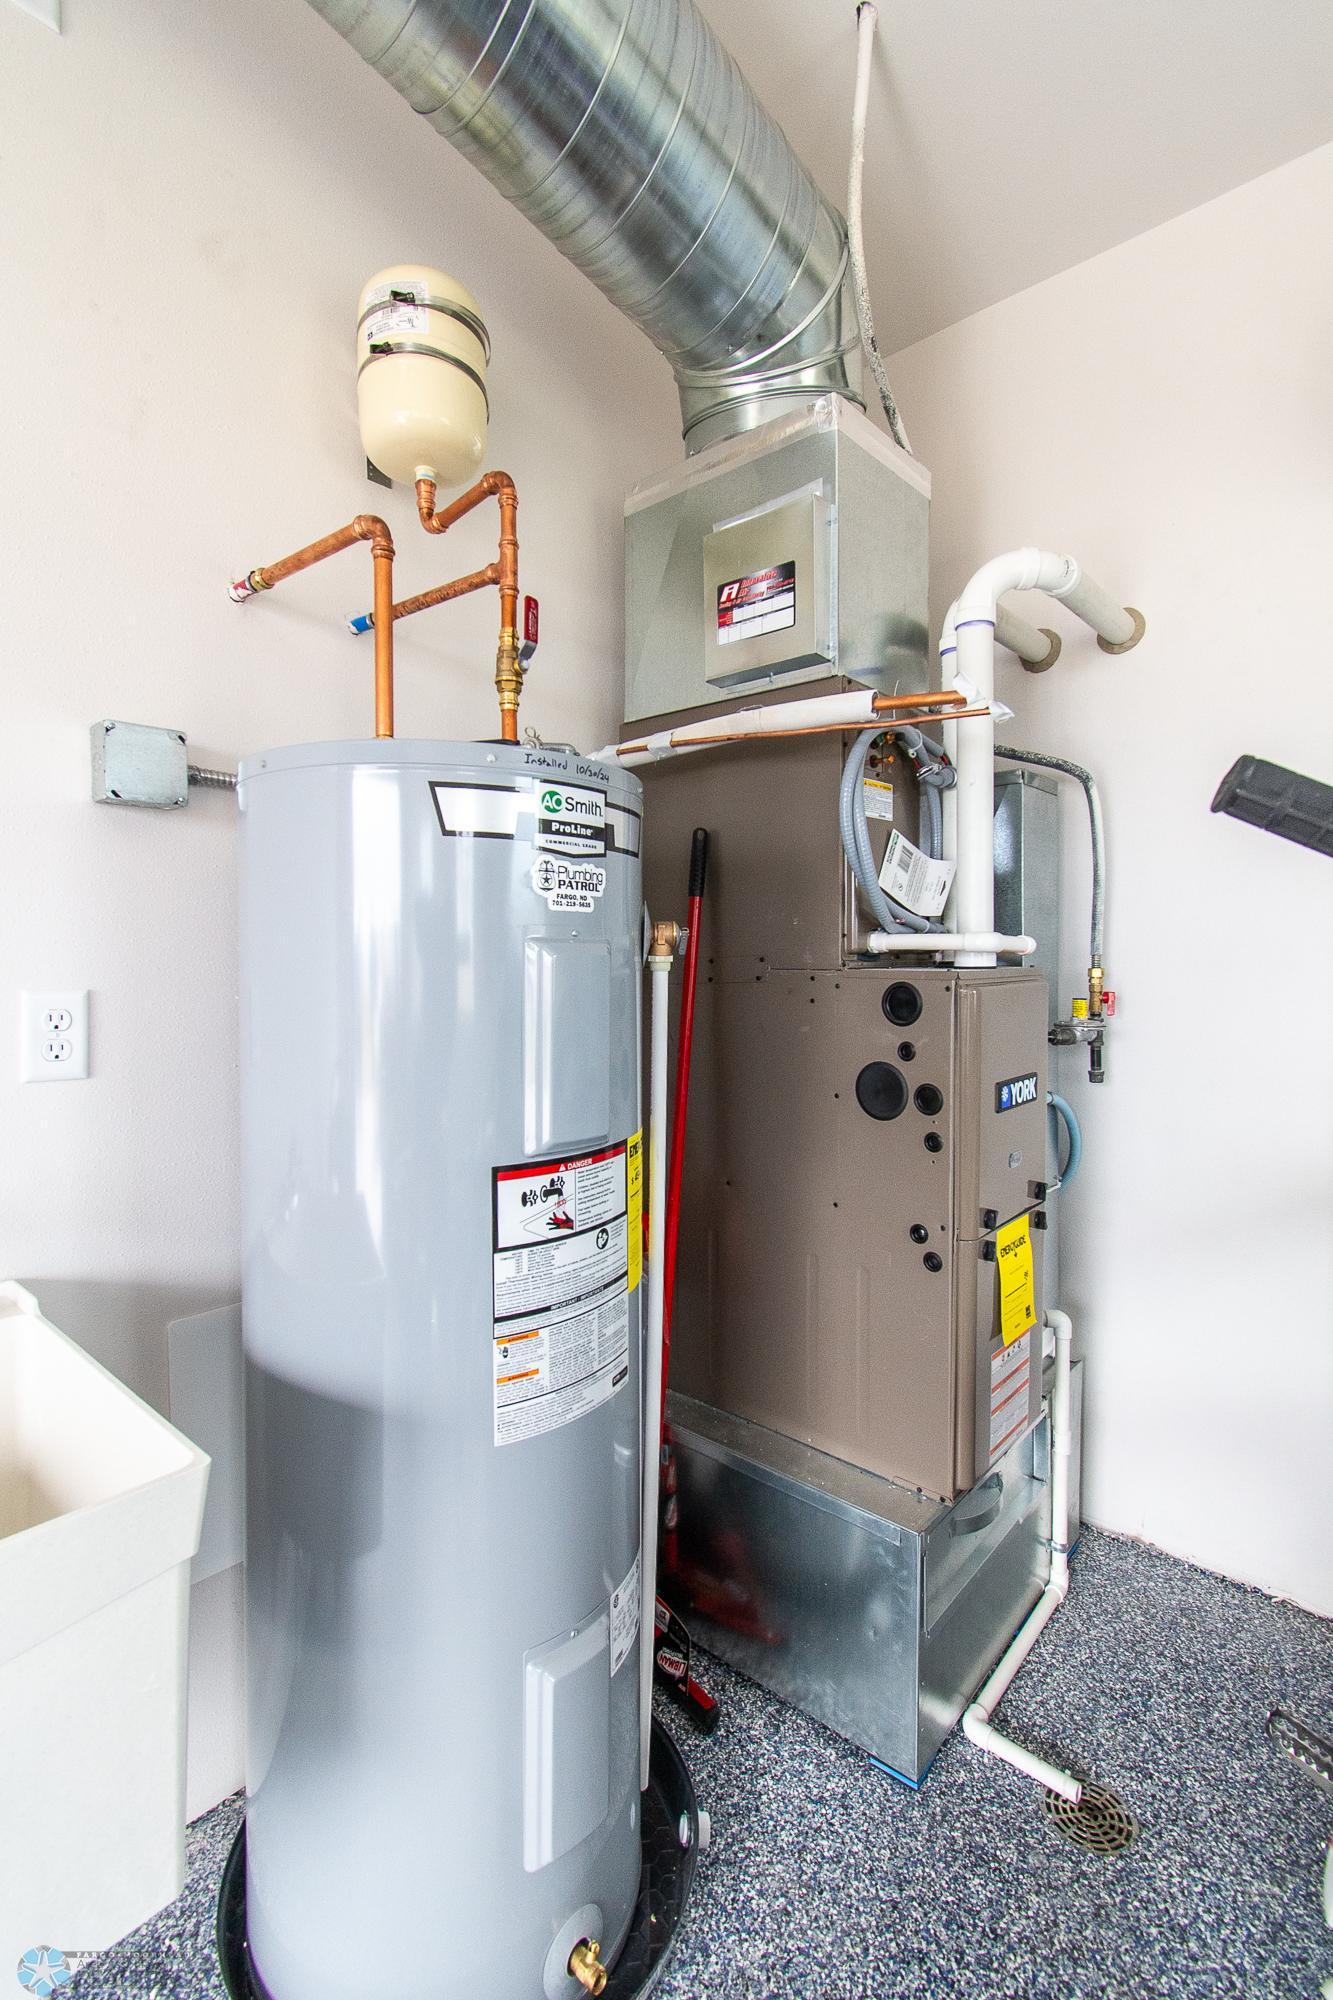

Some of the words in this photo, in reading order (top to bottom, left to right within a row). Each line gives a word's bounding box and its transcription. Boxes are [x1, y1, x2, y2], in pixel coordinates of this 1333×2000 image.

[524, 753, 568, 770] Installed
[565, 796, 602, 817] Smith
[551, 822, 593, 836] ProLine
[557, 865, 603, 886] Plumbing
[558, 880, 600, 893] PATROL
[1010, 1076, 1037, 1106] YORK
[567, 1158, 593, 1170] DANGER
